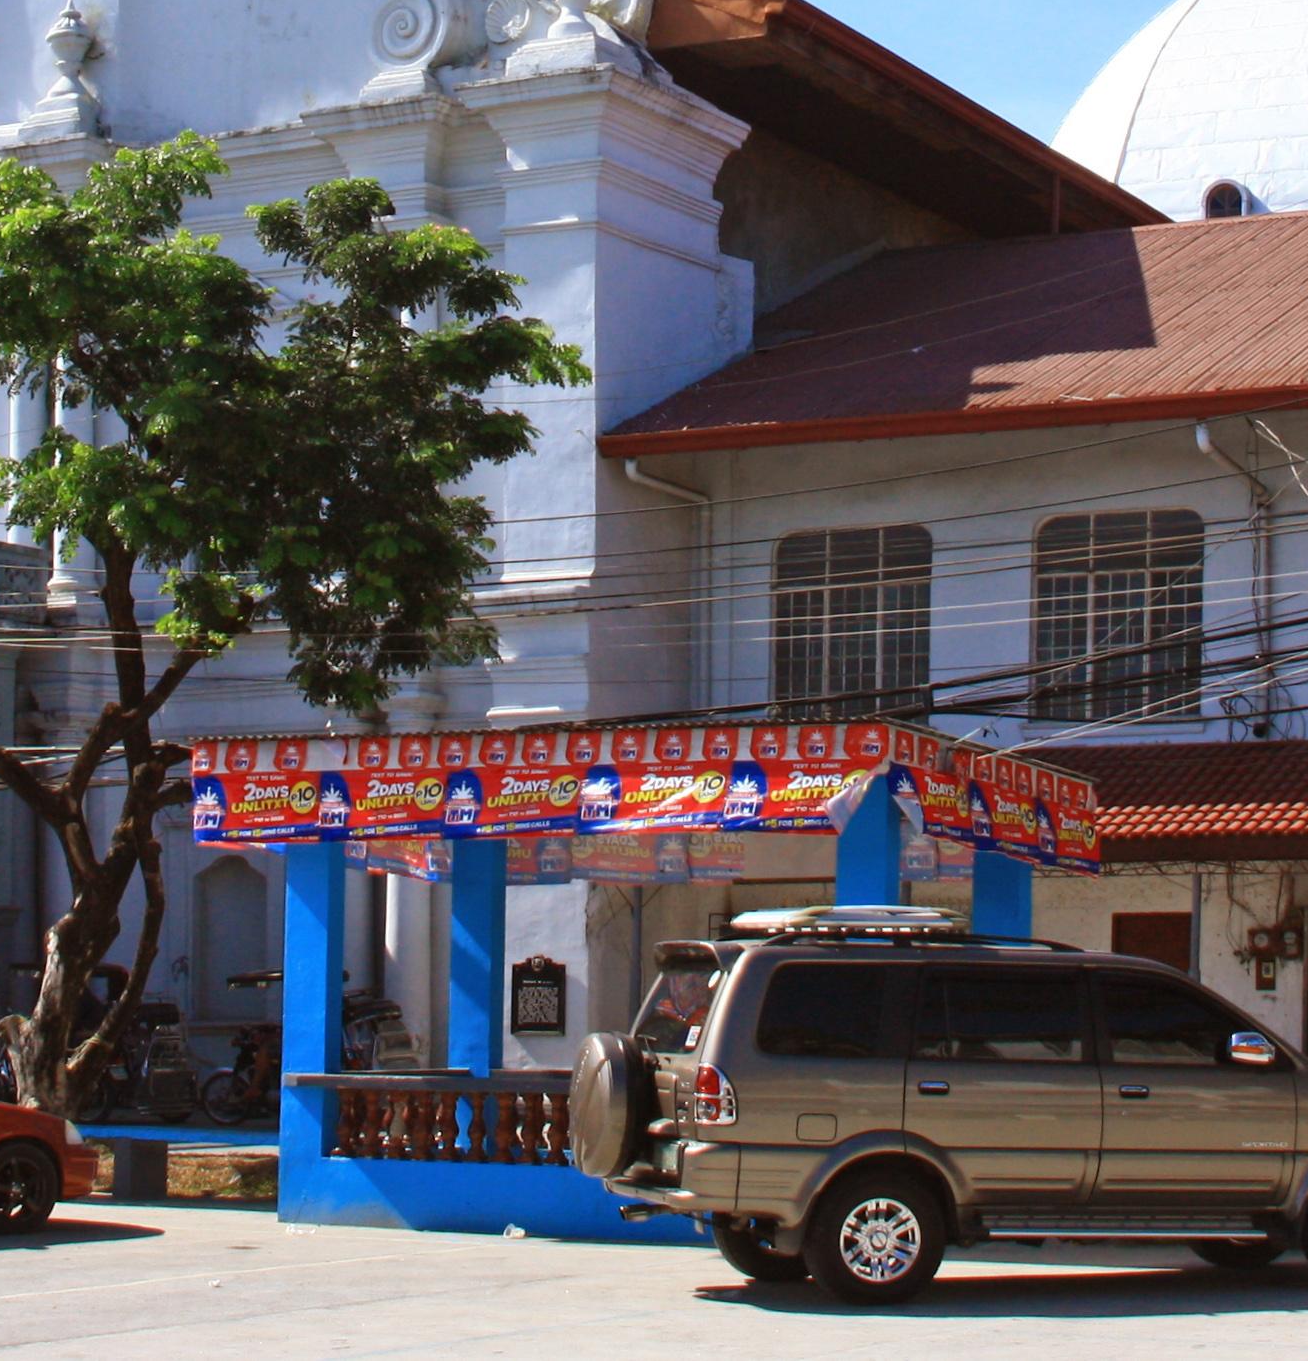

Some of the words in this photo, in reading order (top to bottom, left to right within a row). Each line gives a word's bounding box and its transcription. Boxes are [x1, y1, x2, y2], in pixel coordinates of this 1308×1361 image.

[487, 791, 549, 808] UNLITXT
[770, 787, 841, 802] UNLITXT
[231, 798, 290, 813] UNLITXT
[356, 795, 415, 811] UNLITXT
